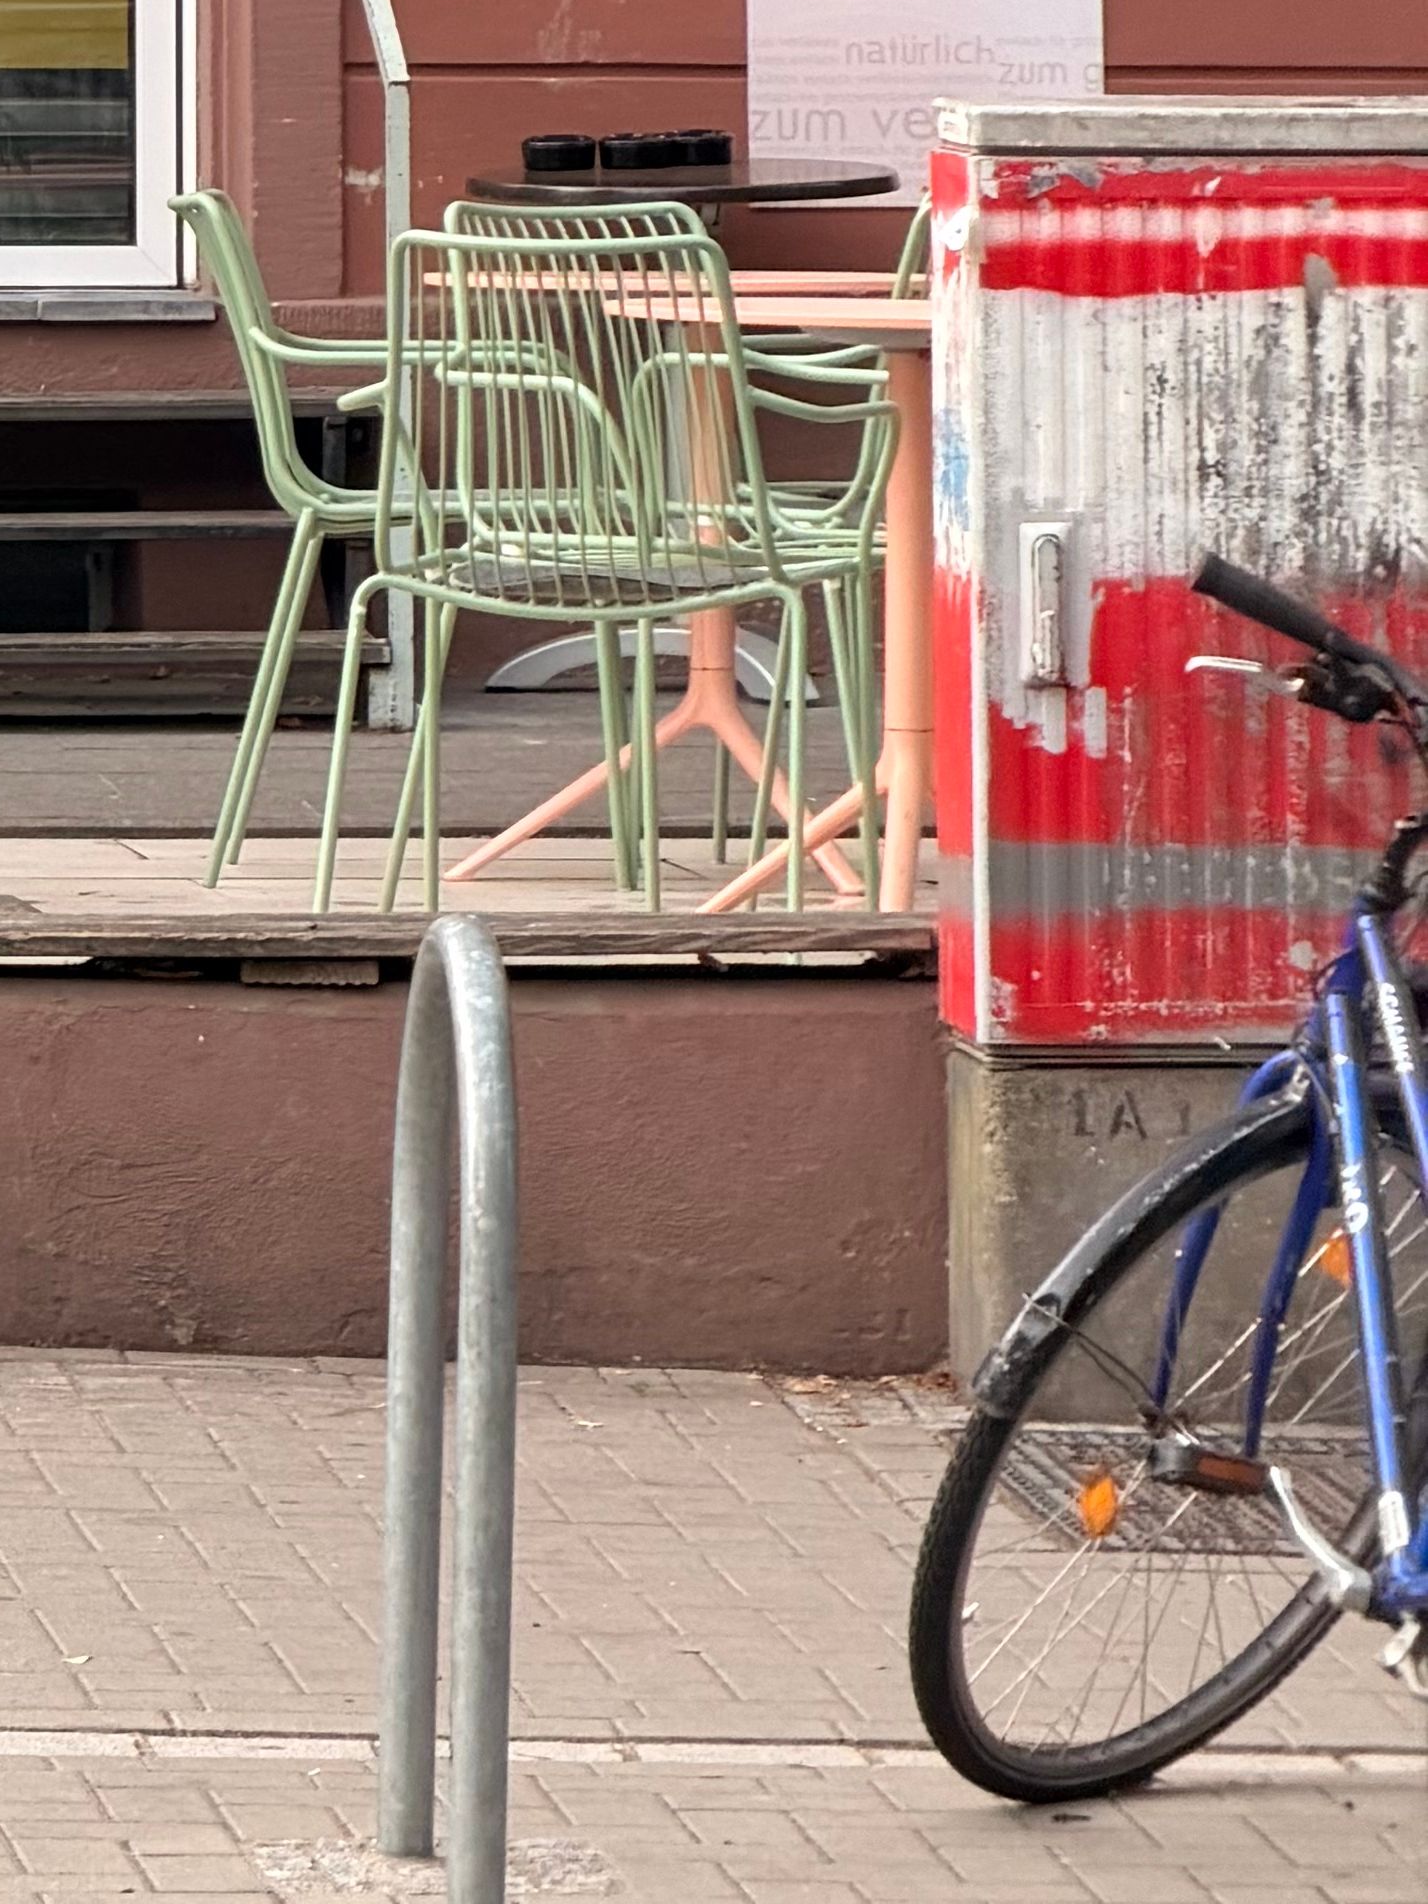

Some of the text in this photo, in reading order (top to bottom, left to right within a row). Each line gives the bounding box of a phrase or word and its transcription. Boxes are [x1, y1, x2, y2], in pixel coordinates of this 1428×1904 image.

[845, 35, 994, 66] natürlich
[998, 60, 1069, 86] zum
[751, 106, 848, 143] zum
